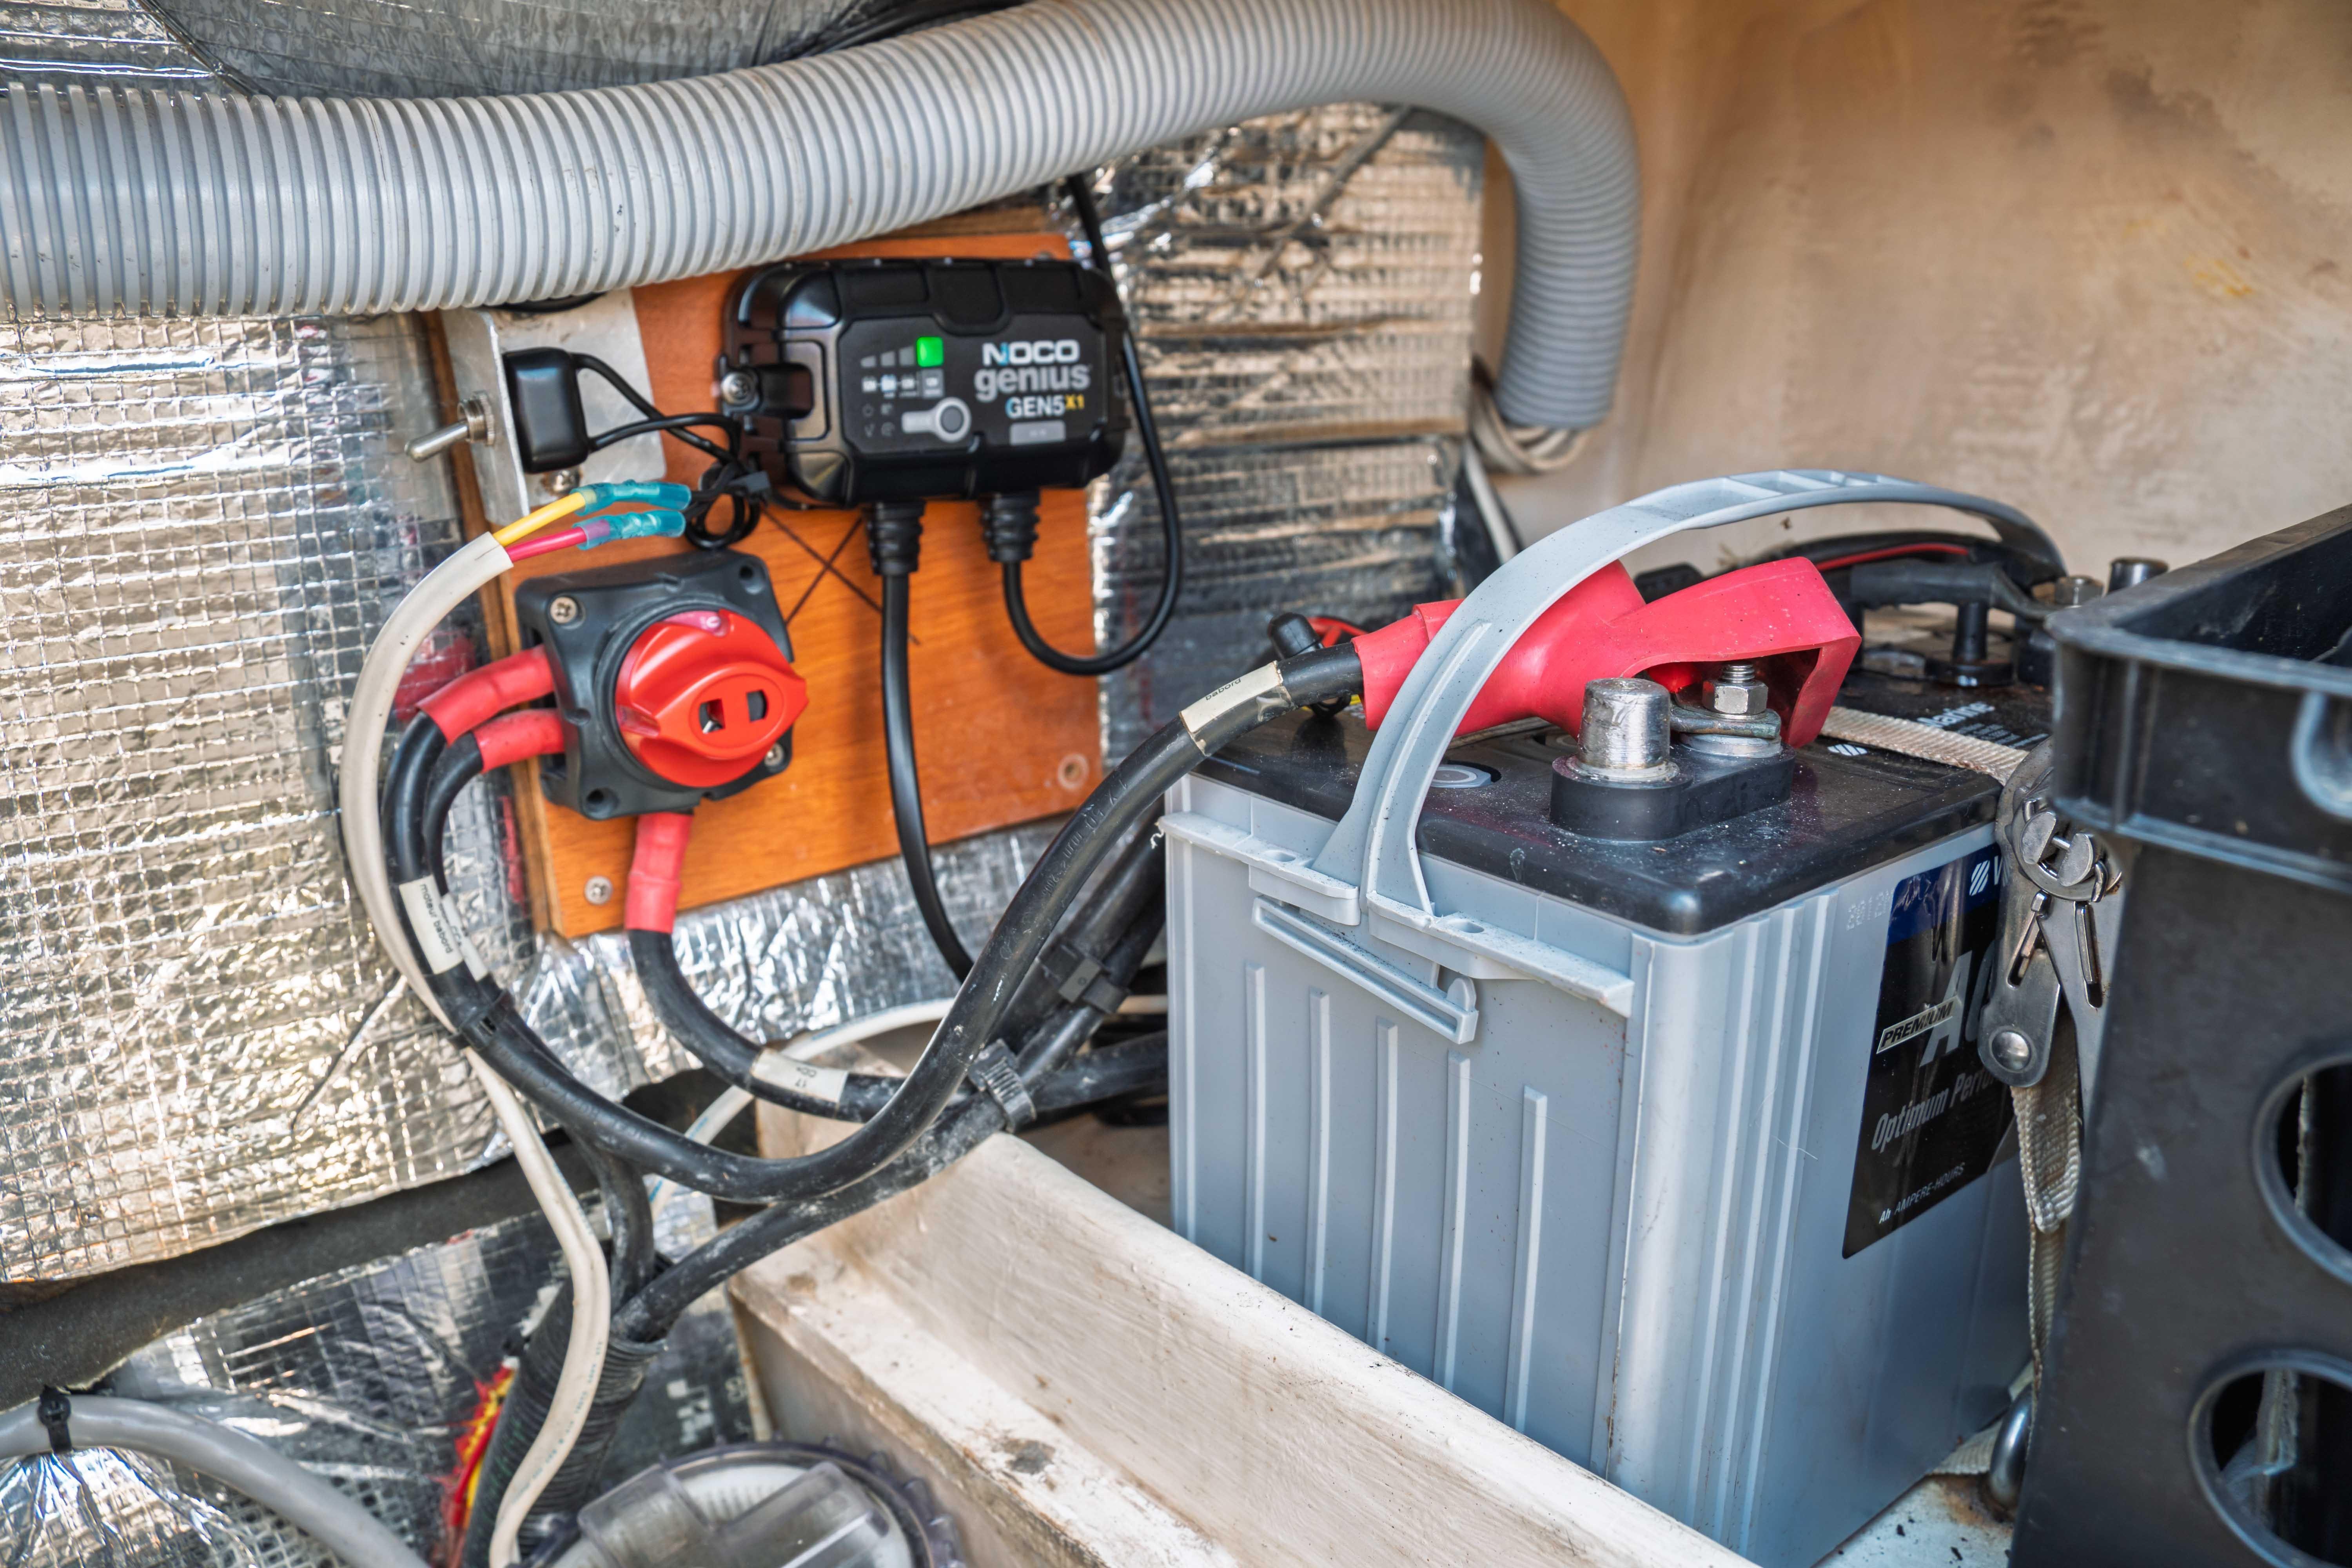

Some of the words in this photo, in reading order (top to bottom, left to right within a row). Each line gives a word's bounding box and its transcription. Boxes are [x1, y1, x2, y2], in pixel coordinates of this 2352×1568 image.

[982, 339, 1080, 366] NOCO
[974, 365, 1091, 402] genius
[419, 883, 437, 919] moteur
[433, 920, 453, 953] babord
[1881, 1000, 1954, 1048] PREMIUM
[1871, 1088, 1949, 1154] Optimum
[1879, 1208, 1892, 1224] Ah
[1894, 1162, 1965, 1215] AMPERE-HOURS
